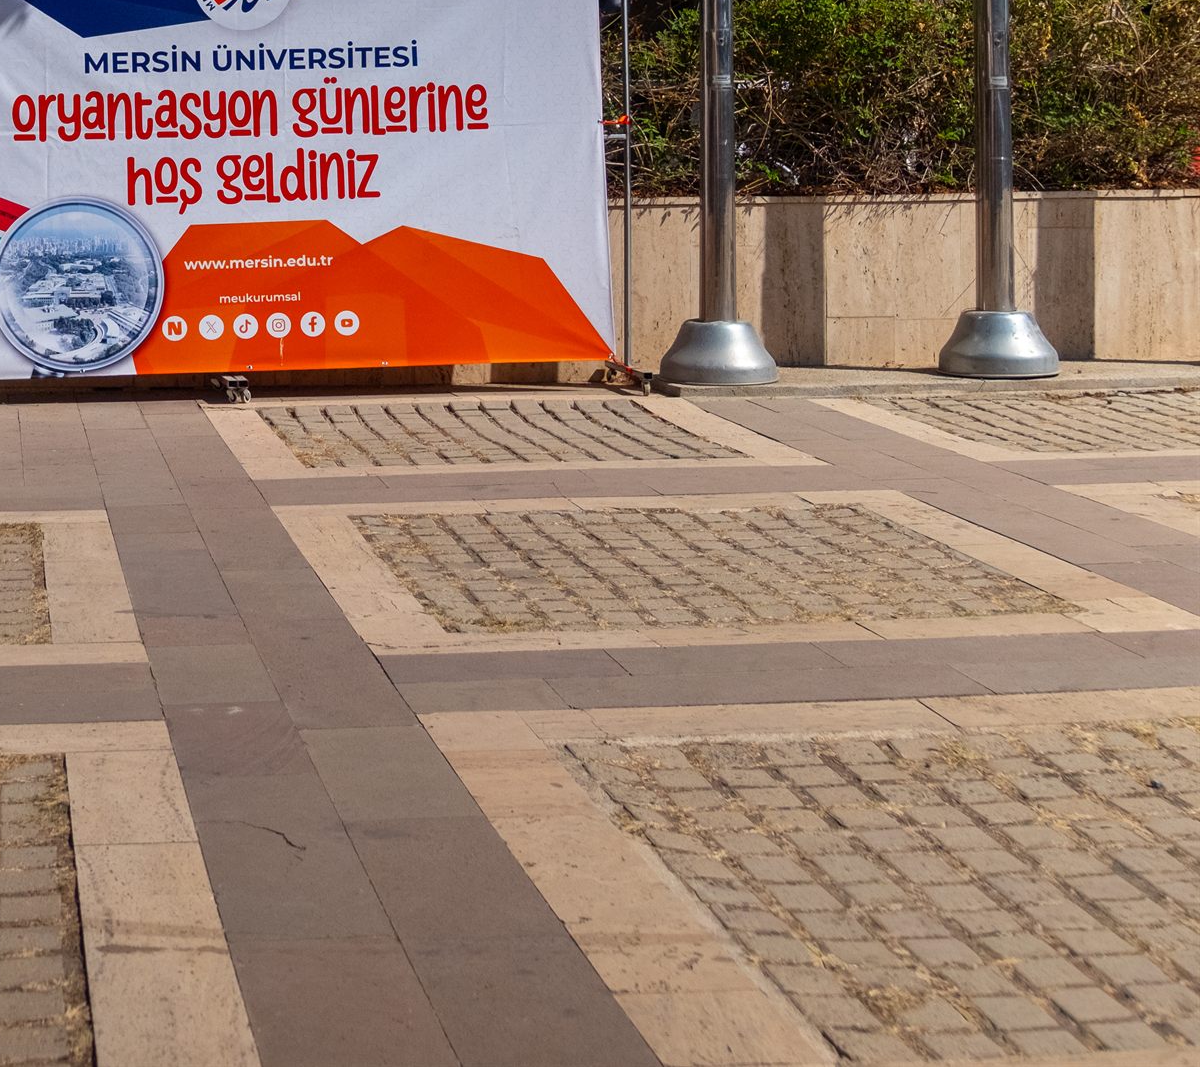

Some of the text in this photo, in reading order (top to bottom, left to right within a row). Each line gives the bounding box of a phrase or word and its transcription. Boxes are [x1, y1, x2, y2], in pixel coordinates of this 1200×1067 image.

[84, 39, 419, 74] MERSİN ÜNİVERSİTESİ
[12, 77, 489, 142] oryantasyon günlerine
[127, 147, 381, 215] hoş geldiniz
[184, 254, 334, 270] www.mersin.edu.tr
[219, 291, 301, 304] meukurumsal
